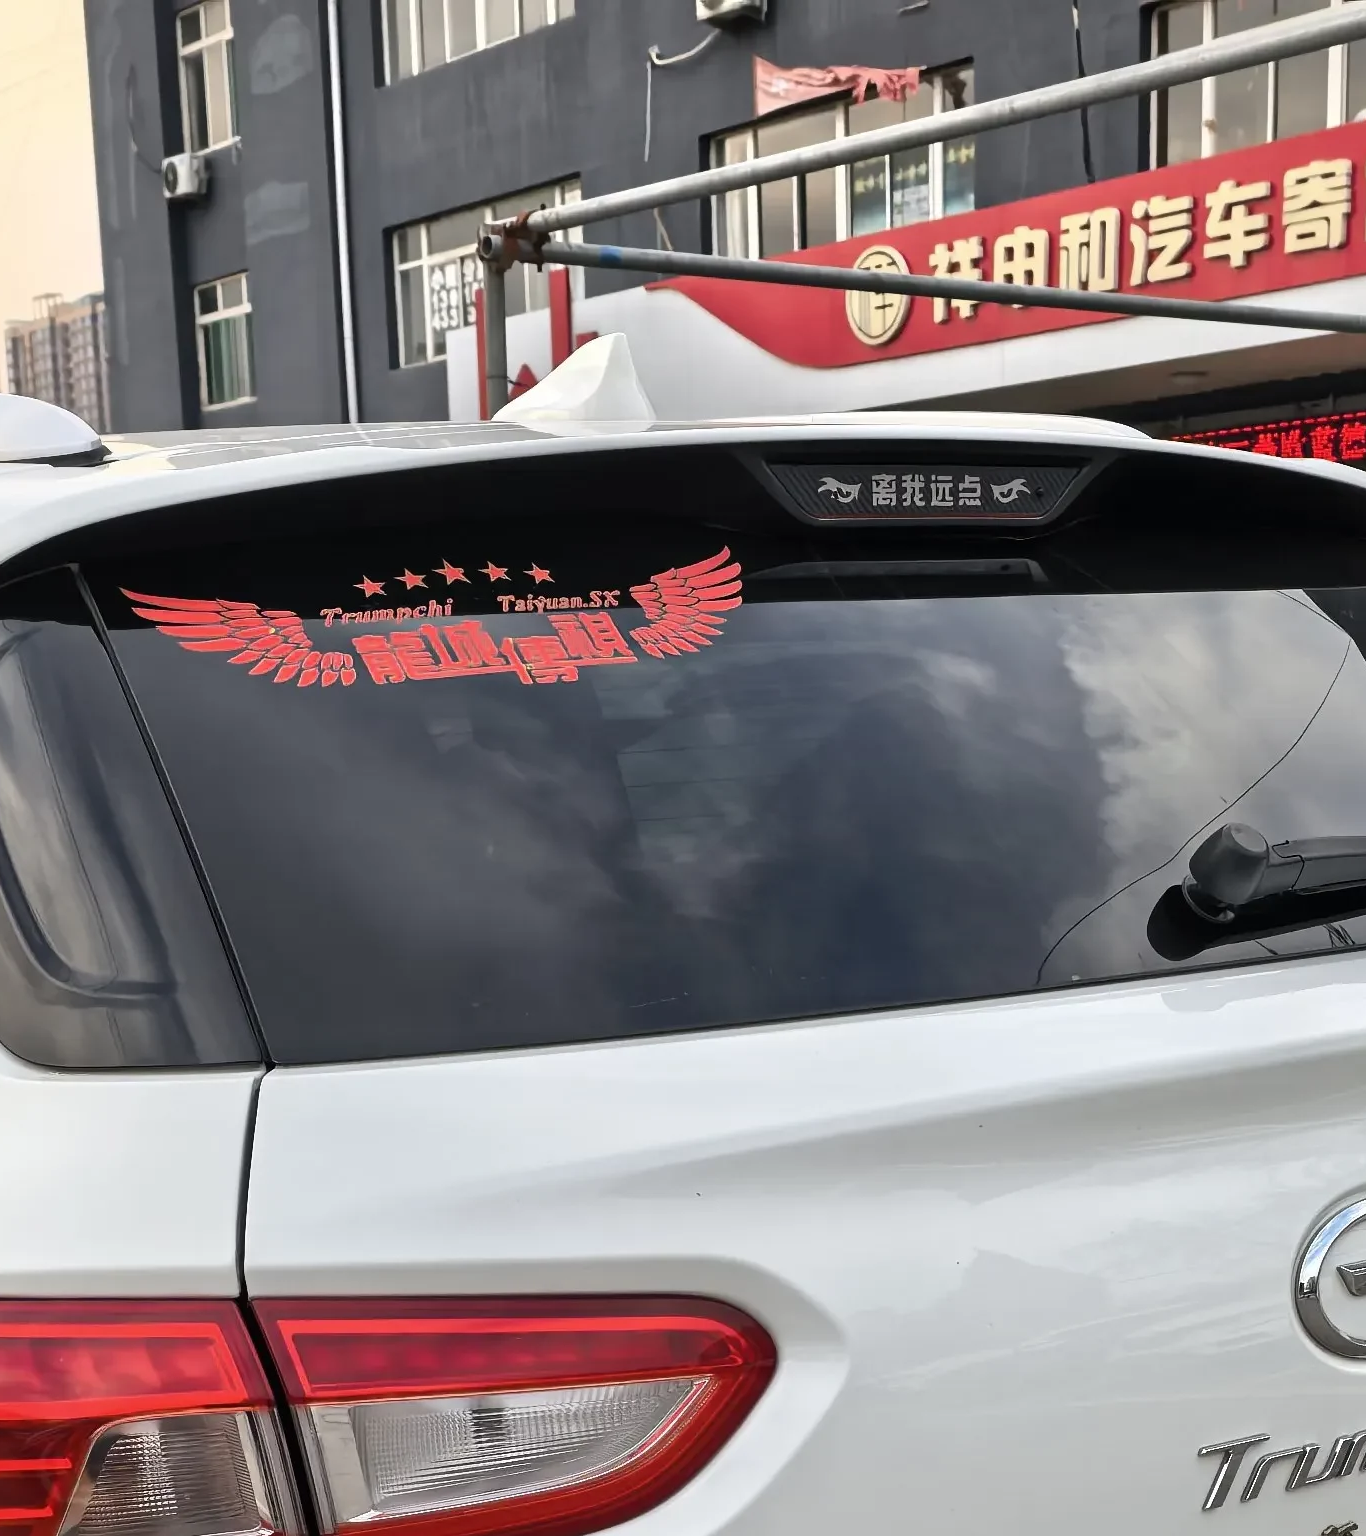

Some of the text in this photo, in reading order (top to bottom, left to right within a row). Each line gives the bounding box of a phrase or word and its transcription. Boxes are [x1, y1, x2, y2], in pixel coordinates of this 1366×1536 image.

[871, 473, 982, 507] 离我远点
[321, 598, 454, 627] Trumpchi
